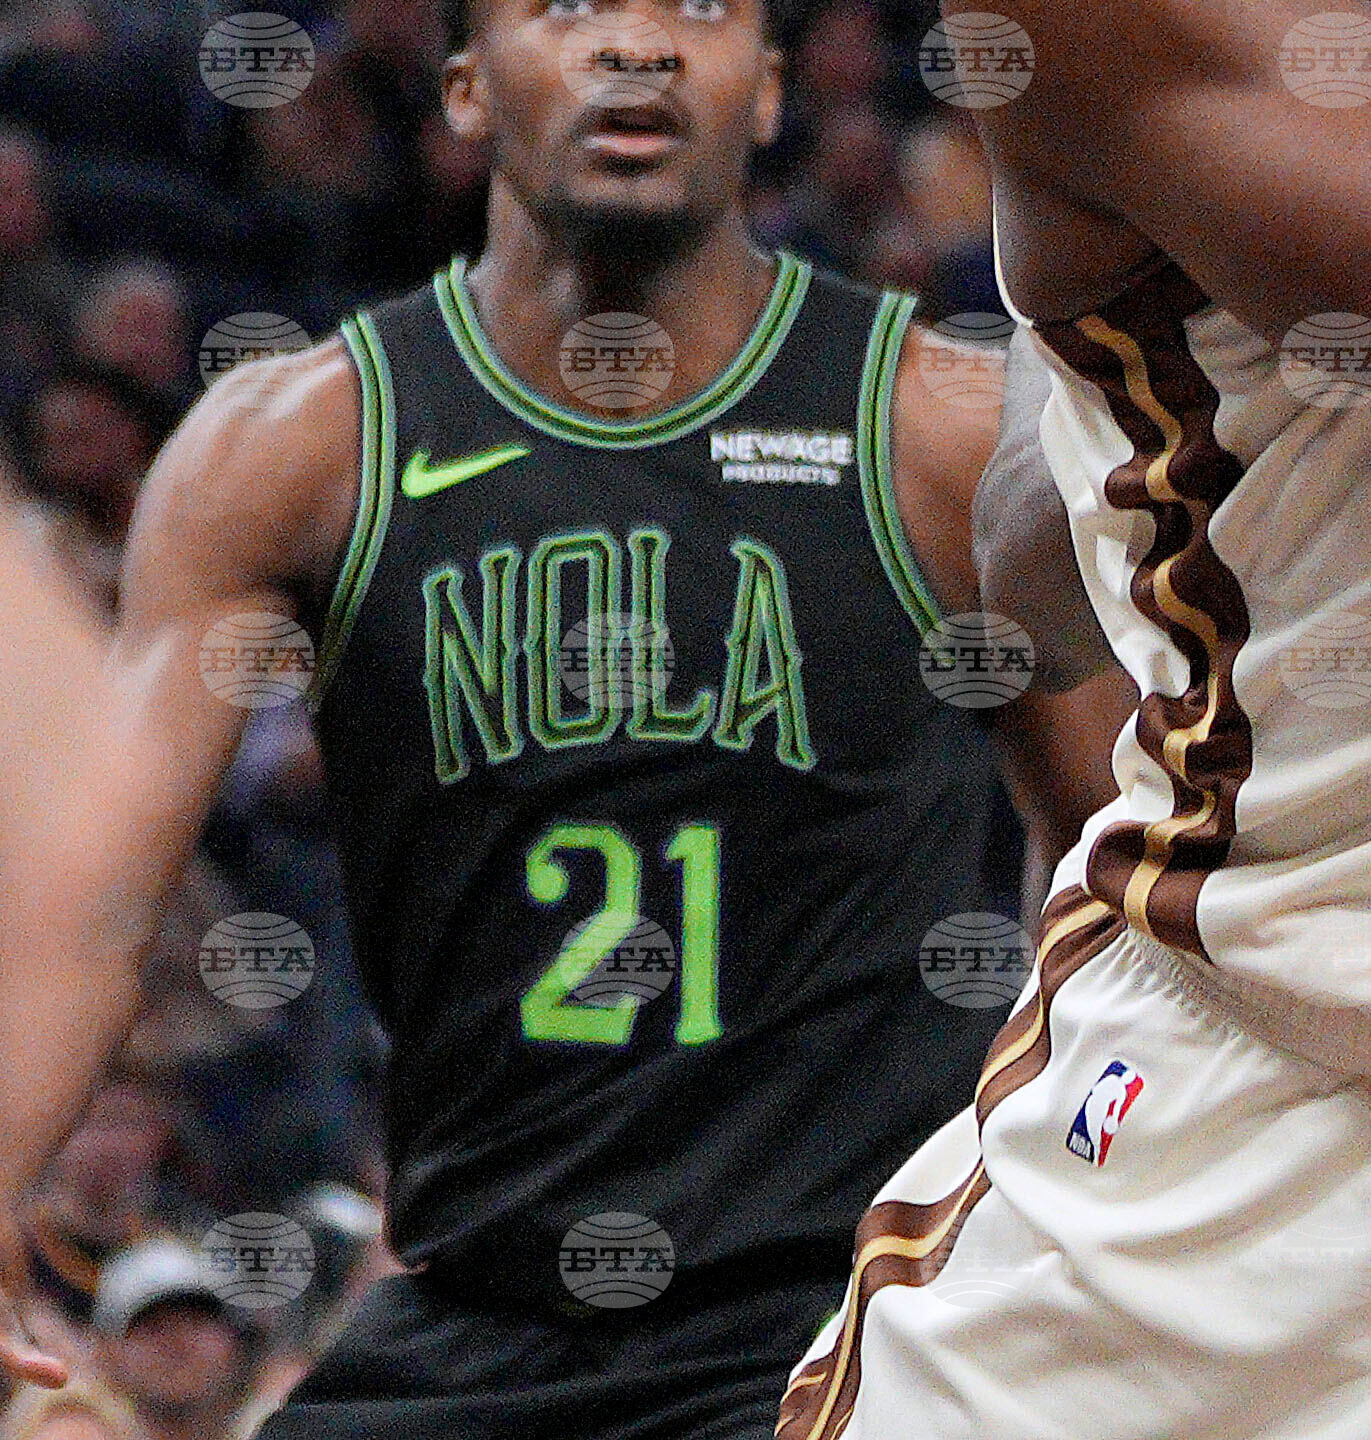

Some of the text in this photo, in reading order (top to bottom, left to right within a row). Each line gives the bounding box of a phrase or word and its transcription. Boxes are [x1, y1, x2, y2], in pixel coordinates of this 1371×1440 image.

[710, 431, 853, 464] NEWAGE
[423, 527, 817, 785] NOLA
[519, 821, 724, 1047] 21
